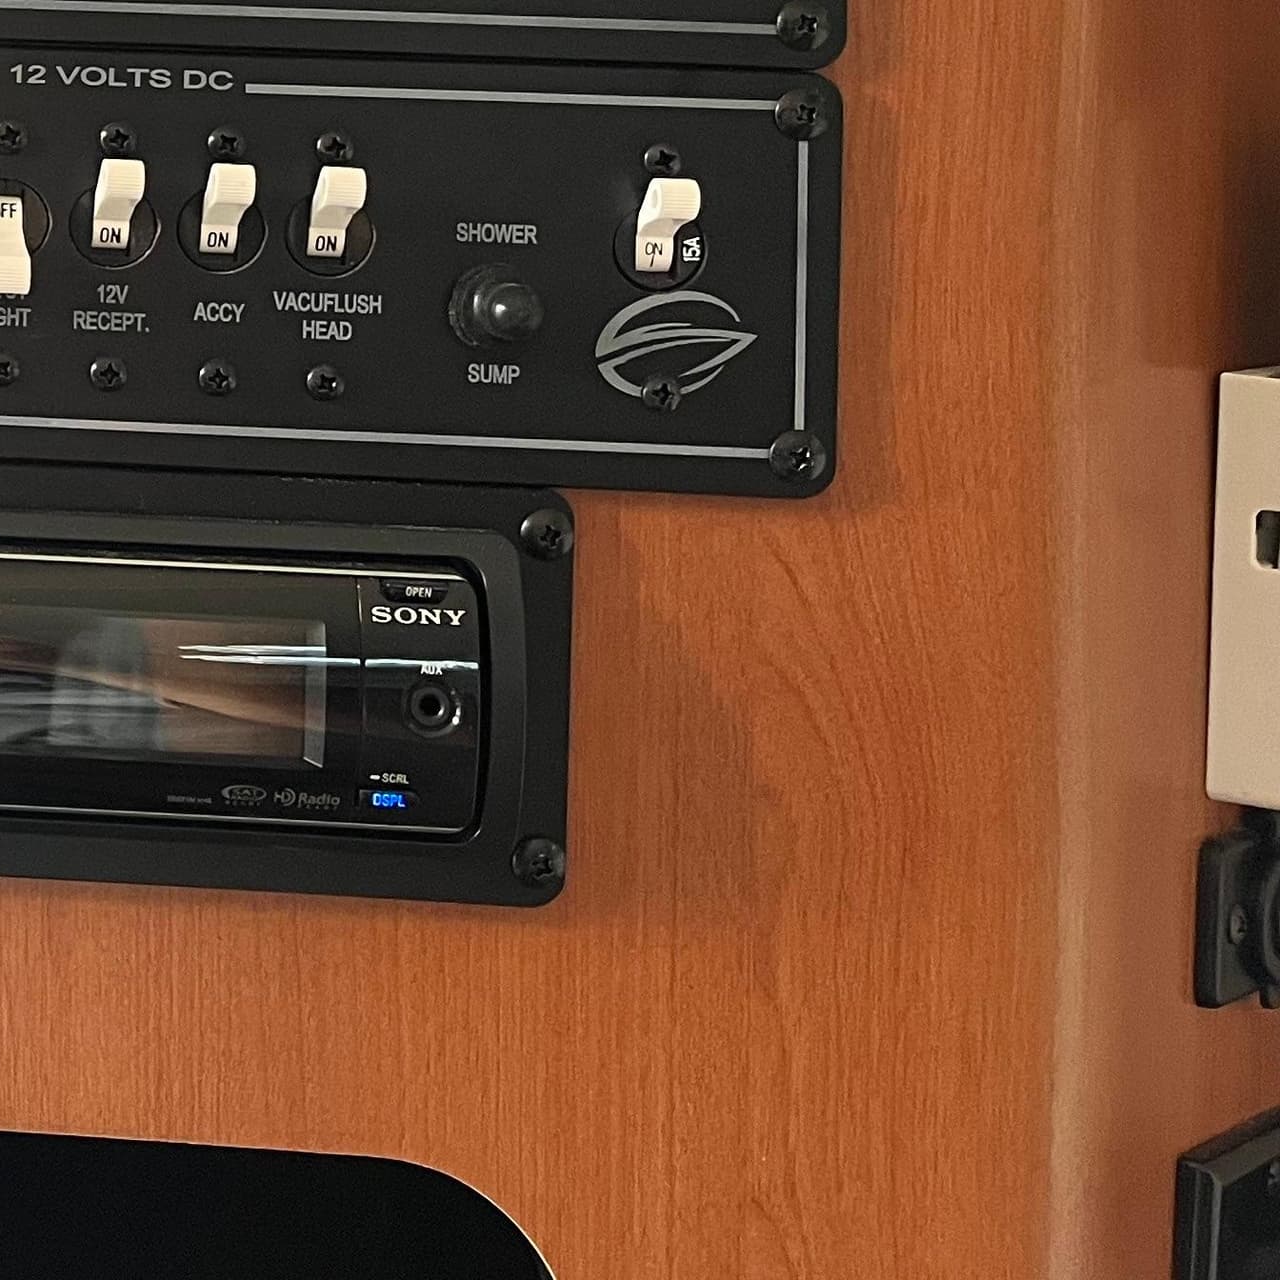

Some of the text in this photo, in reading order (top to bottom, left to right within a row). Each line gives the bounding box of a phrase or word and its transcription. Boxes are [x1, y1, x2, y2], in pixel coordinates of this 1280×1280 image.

[10, 65, 235, 90] 12 VOLTS DC
[99, 228, 121, 244] ON
[207, 232, 229, 249] ON
[456, 222, 538, 245] SHOWER
[314, 236, 337, 252] ON
[682, 236, 701, 262] 15A
[97, 285, 128, 304] 12V
[273, 291, 382, 315] VACUFLUSH
[73, 311, 149, 333] RECEPT.
[194, 302, 245, 322] ACCY
[302, 321, 352, 341] HEAD
[467, 363, 520, 385] SUMP
[405, 585, 433, 599] OPEN
[371, 606, 467, 626] SONY
[381, 773, 409, 786] SCRL
[298, 793, 341, 808] Radio
[371, 793, 406, 809] DSPL
